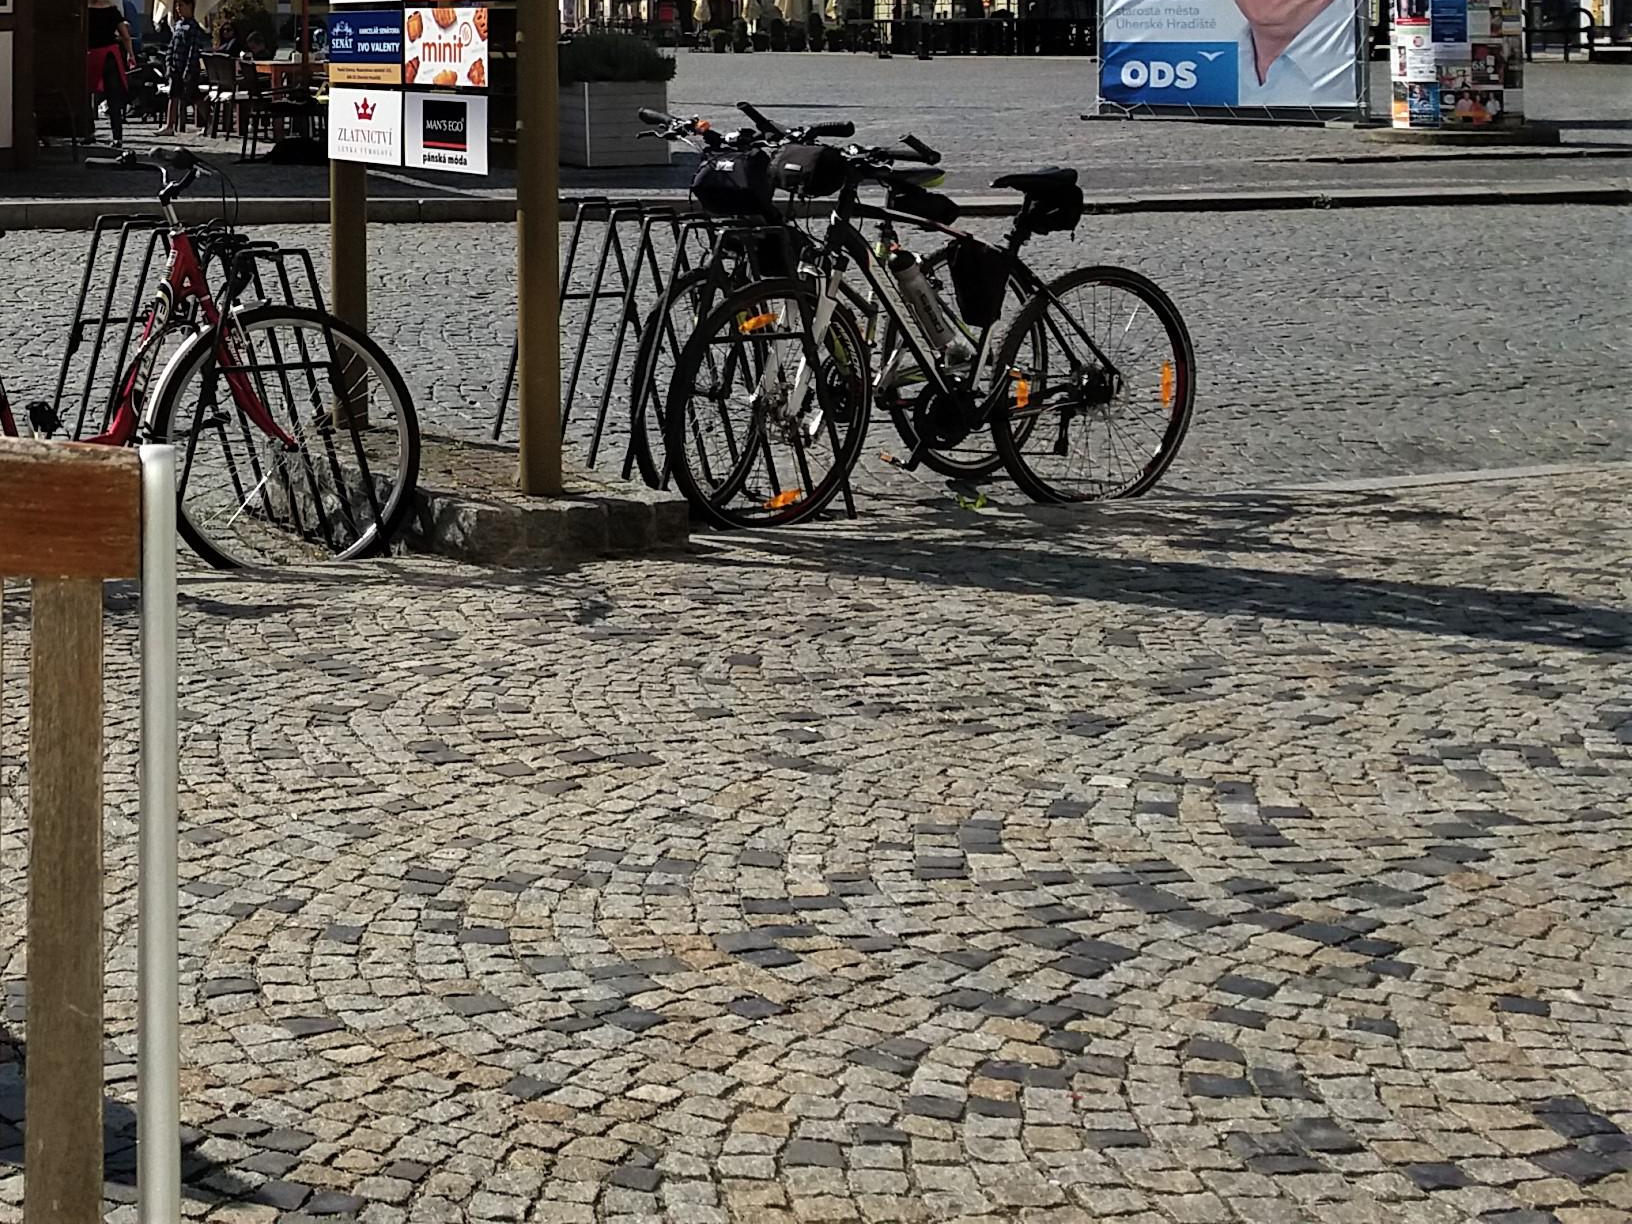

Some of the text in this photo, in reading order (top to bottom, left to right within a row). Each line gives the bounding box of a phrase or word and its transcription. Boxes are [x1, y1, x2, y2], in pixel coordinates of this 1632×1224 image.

[1116, 5, 1200, 16] starosta města
[1116, 18, 1217, 30] Uherské Hradiště
[331, 36, 353, 49] SENÁT
[358, 42, 401, 53] IVO VALENTY
[422, 34, 463, 63] minit
[1121, 60, 1198, 89] ODS
[338, 127, 393, 146] ZLATNICTVÍ
[448, 155, 468, 166] móda
